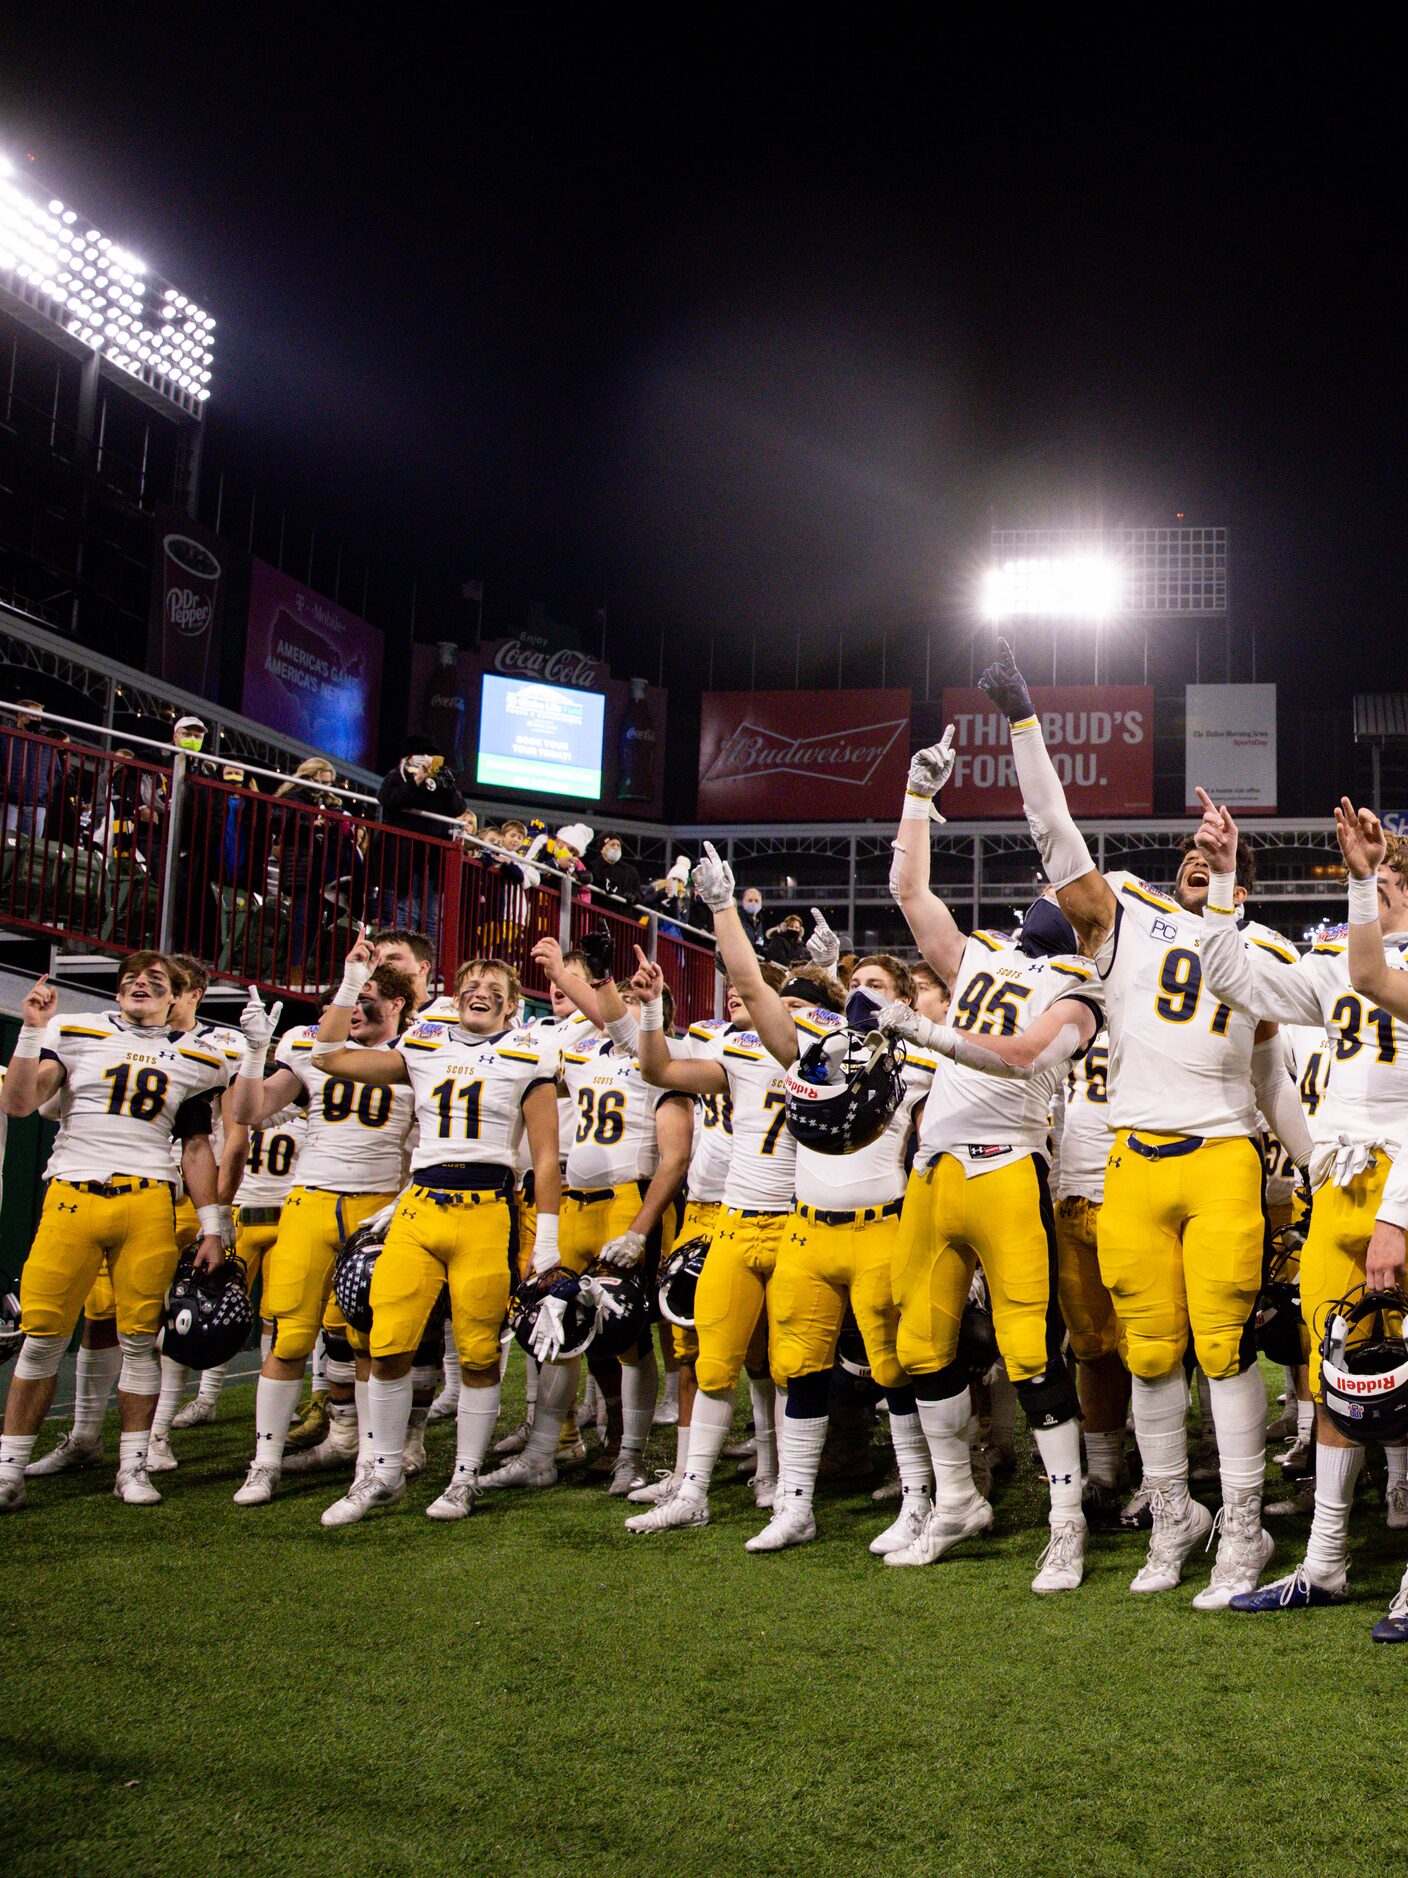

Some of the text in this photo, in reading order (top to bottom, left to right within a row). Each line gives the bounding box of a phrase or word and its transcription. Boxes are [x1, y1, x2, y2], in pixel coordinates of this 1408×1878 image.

[167, 587, 209, 628] Pepper
[520, 632, 549, 647] Enjoy
[264, 656, 319, 693] AMERICA'S
[278, 640, 329, 677] AMERICA'S
[954, 711, 1144, 746] THI BUD'S
[720, 734, 885, 767] Budweiser
[954, 753, 1107, 788] FOR OU.
[1151, 920, 1177, 940] PC
[996, 967, 1023, 980] SCOTS
[952, 971, 1034, 1037] 95
[1330, 993, 1399, 1065] 31
[126, 1052, 158, 1065] SCOTS
[446, 1065, 475, 1075] SCOTS
[1067, 1046, 1109, 1104] 5
[103, 1062, 170, 1123] 18
[592, 1076, 614, 1085] SCOTS
[1300, 1051, 1332, 1116] 4
[322, 1075, 395, 1131] 90
[430, 1077, 485, 1140] 11
[576, 1085, 628, 1146] 36
[246, 1129, 297, 1176] 40
[1337, 1375, 1395, 1393] Riddell
